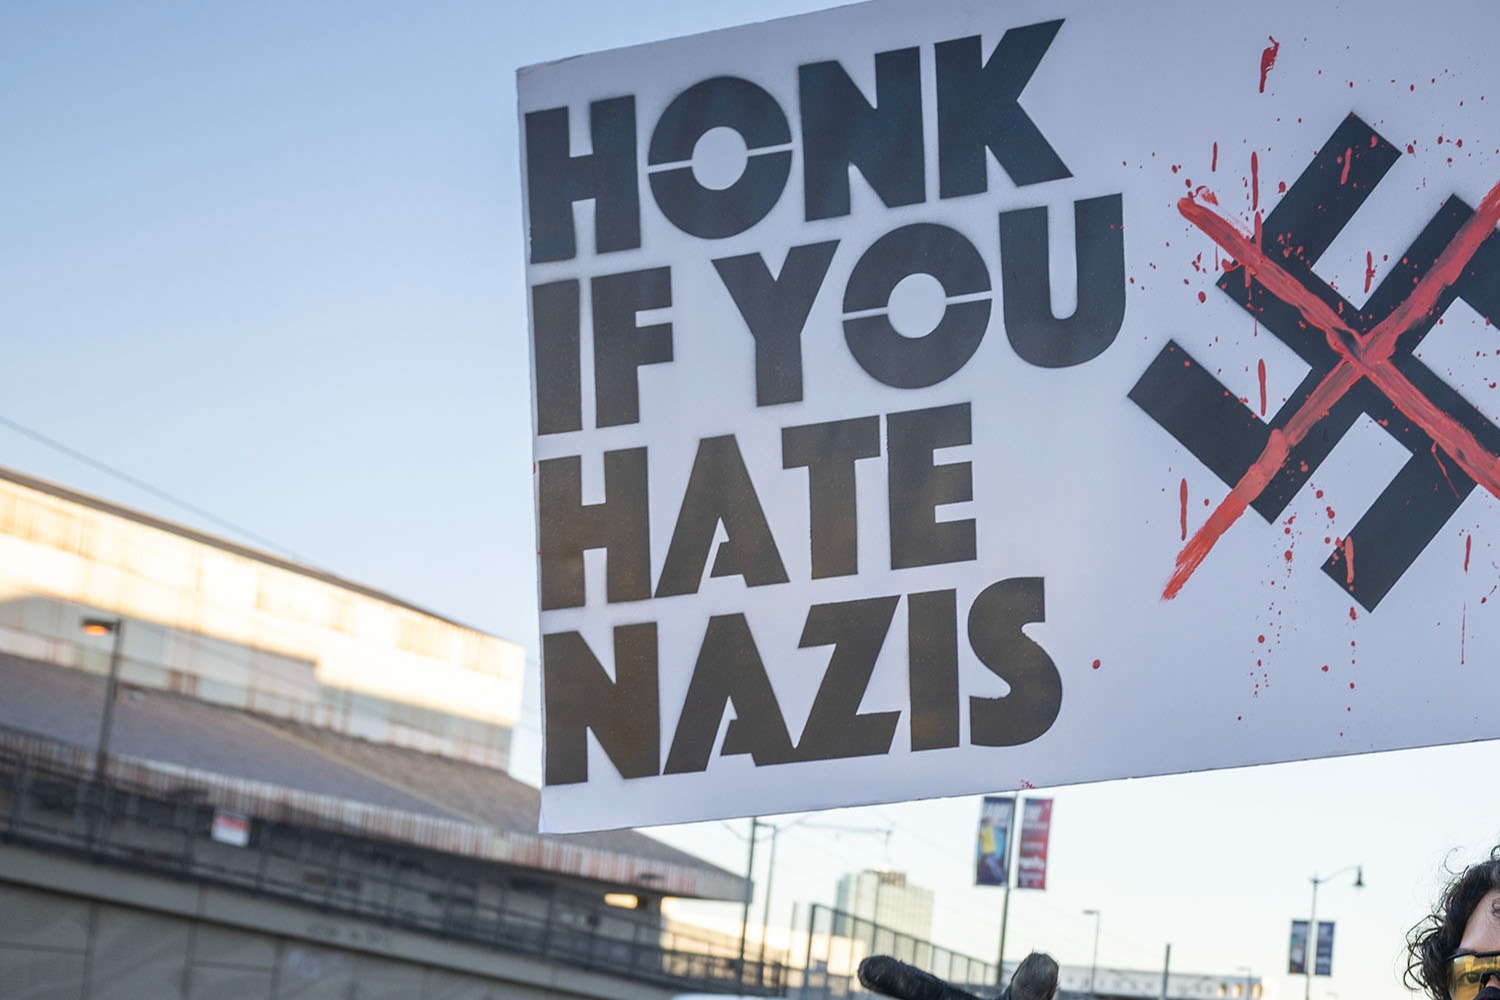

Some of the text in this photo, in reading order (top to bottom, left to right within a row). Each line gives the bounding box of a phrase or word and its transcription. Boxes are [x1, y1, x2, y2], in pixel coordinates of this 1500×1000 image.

[524, 18, 1074, 264] HONK
[532, 192, 1127, 437] IF YOU
[538, 401, 978, 612] HATE
[542, 576, 1063, 786] NAZIS
